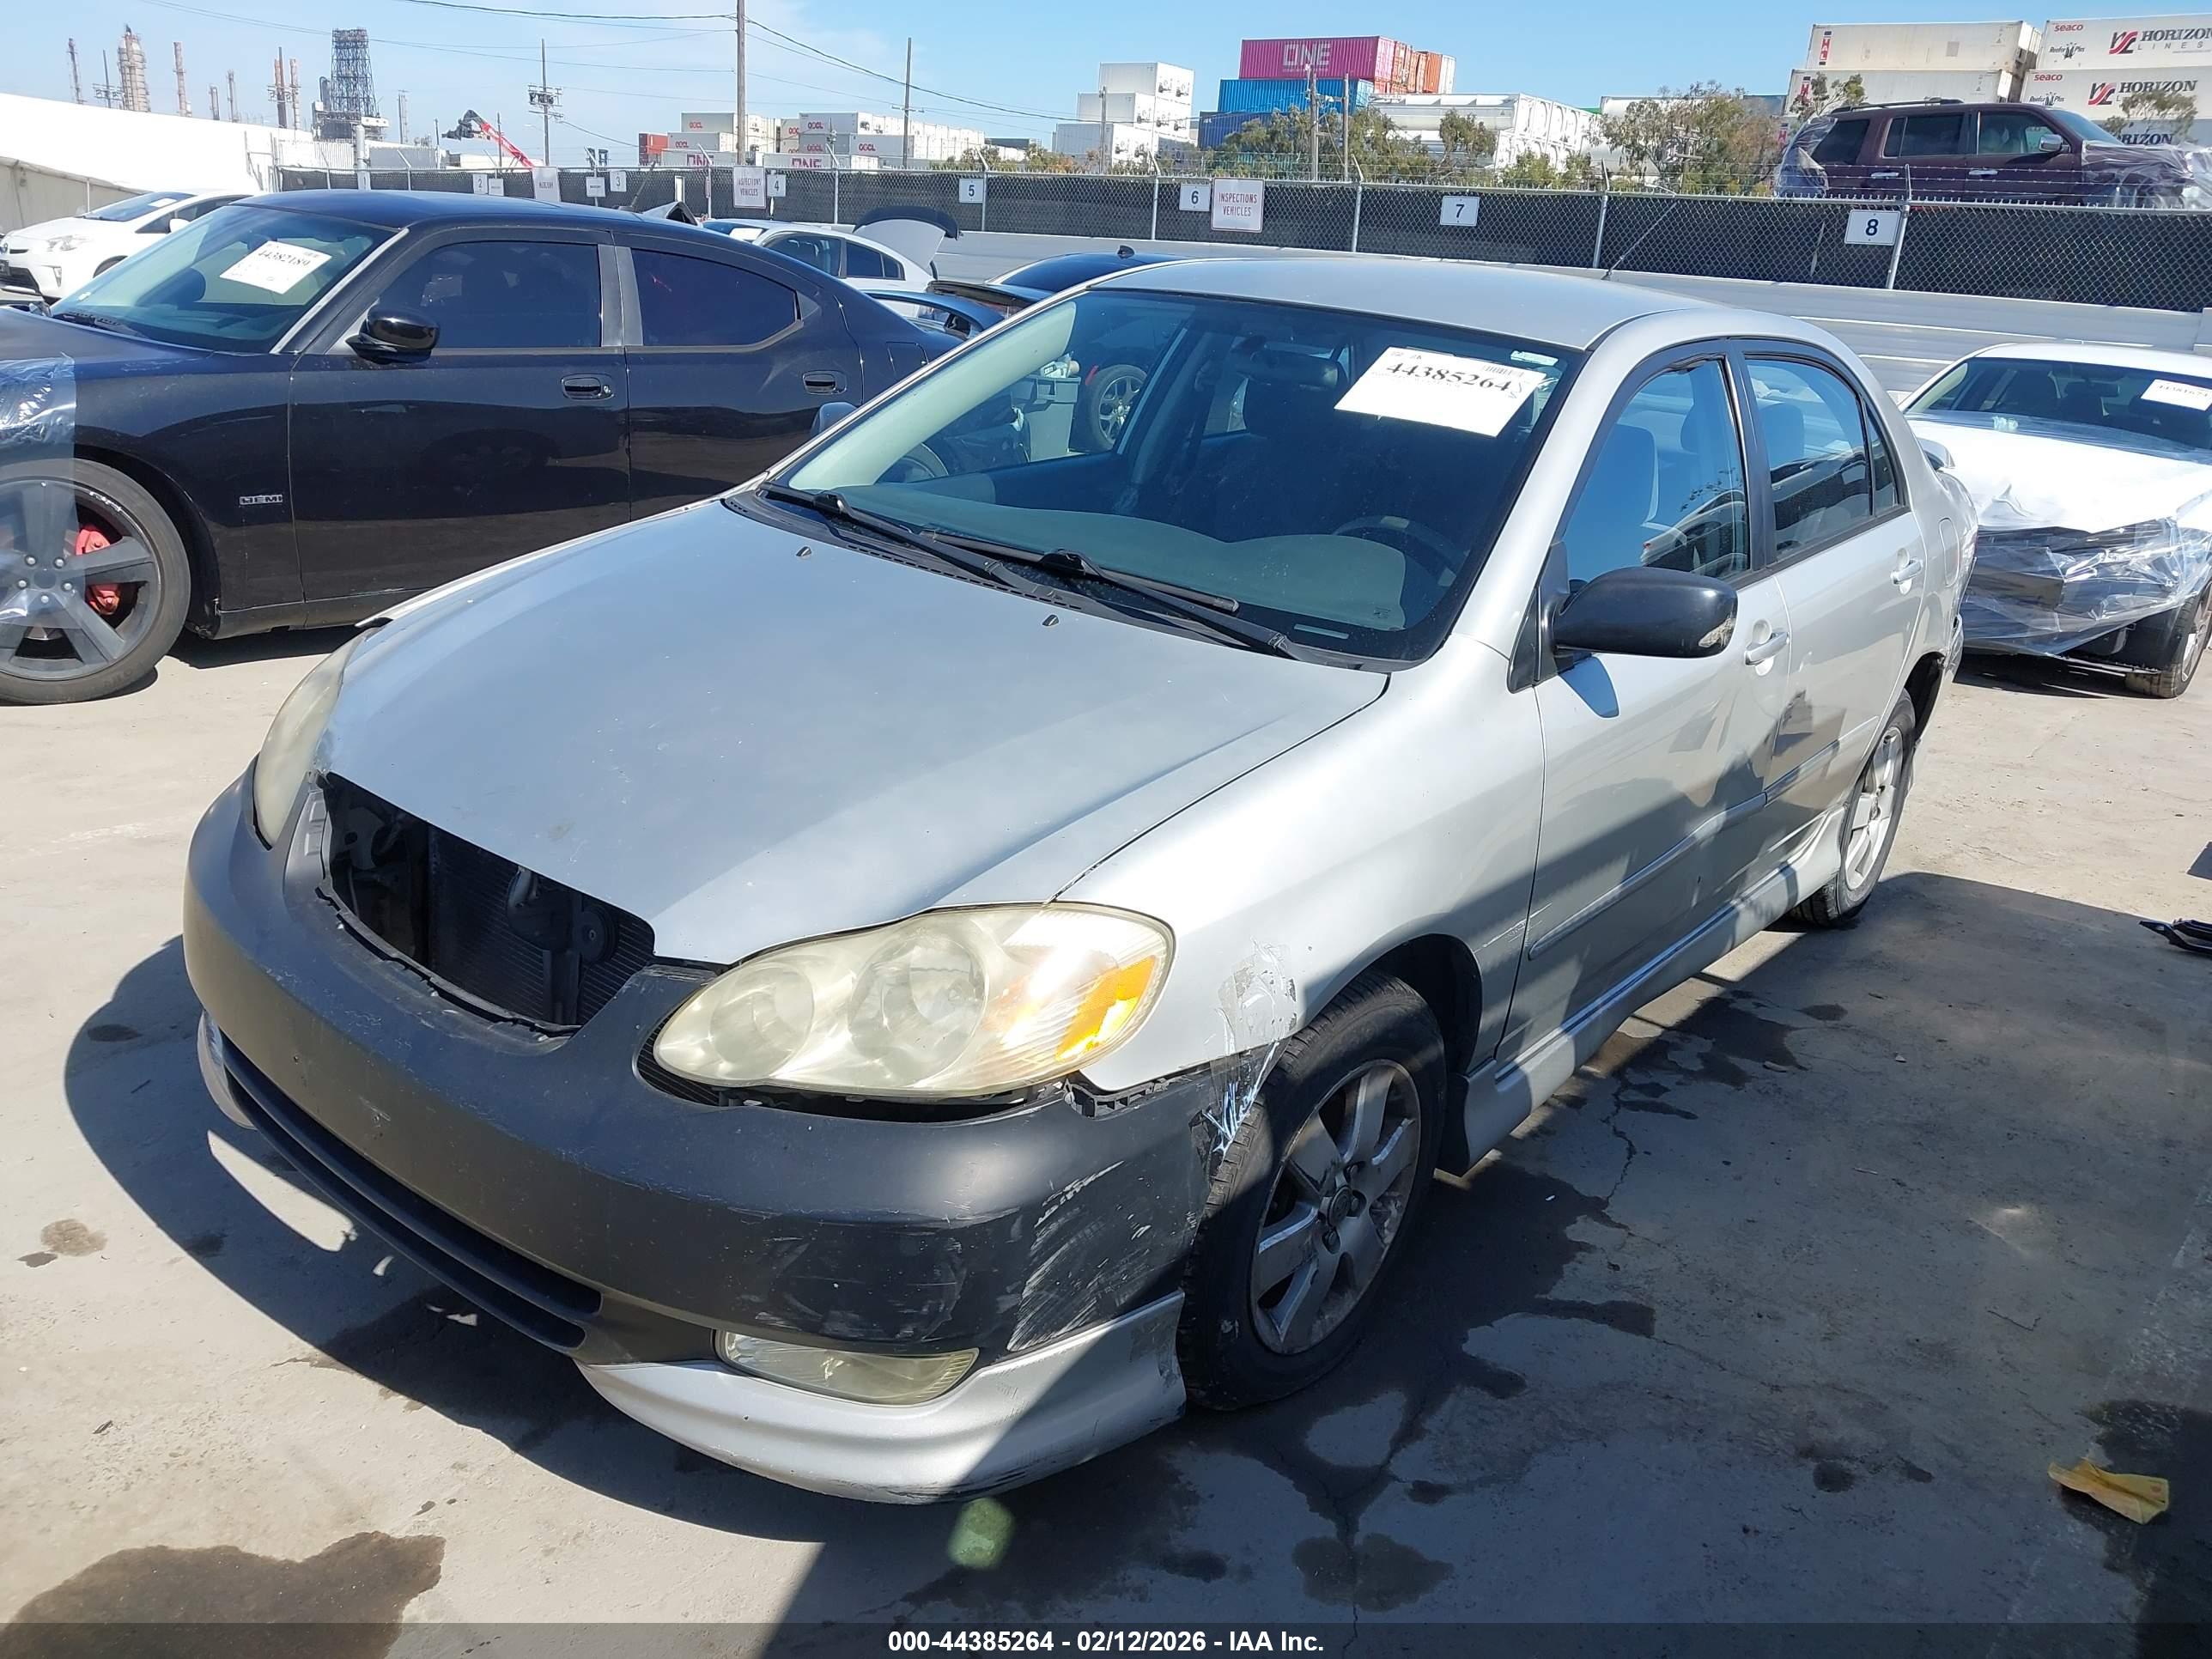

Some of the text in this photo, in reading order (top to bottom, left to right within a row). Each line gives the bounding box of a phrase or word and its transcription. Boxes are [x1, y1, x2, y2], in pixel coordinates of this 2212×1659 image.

[2137, 41, 2203, 51] LINES
[1284, 44, 1330, 66] ONE
[2118, 80, 2198, 93] HORIZON
[807, 121, 823, 130] OOCL
[2121, 133, 2172, 145] RIZON
[859, 143, 876, 152] OOCL
[477, 178, 483, 188] 2
[616, 176, 621, 186] 3
[774, 180, 780, 191] 4
[968, 184, 975, 197] 5
[1191, 191, 1199, 204] 6
[1218, 192, 1257, 204] INSPECTIONS
[1223, 205, 1251, 217] VEHICLES
[1455, 204, 1465, 218] 7
[1865, 218, 1879, 236] 8
[1387, 362, 1512, 392] 44385264
[240, 495, 283, 505] HEMI
